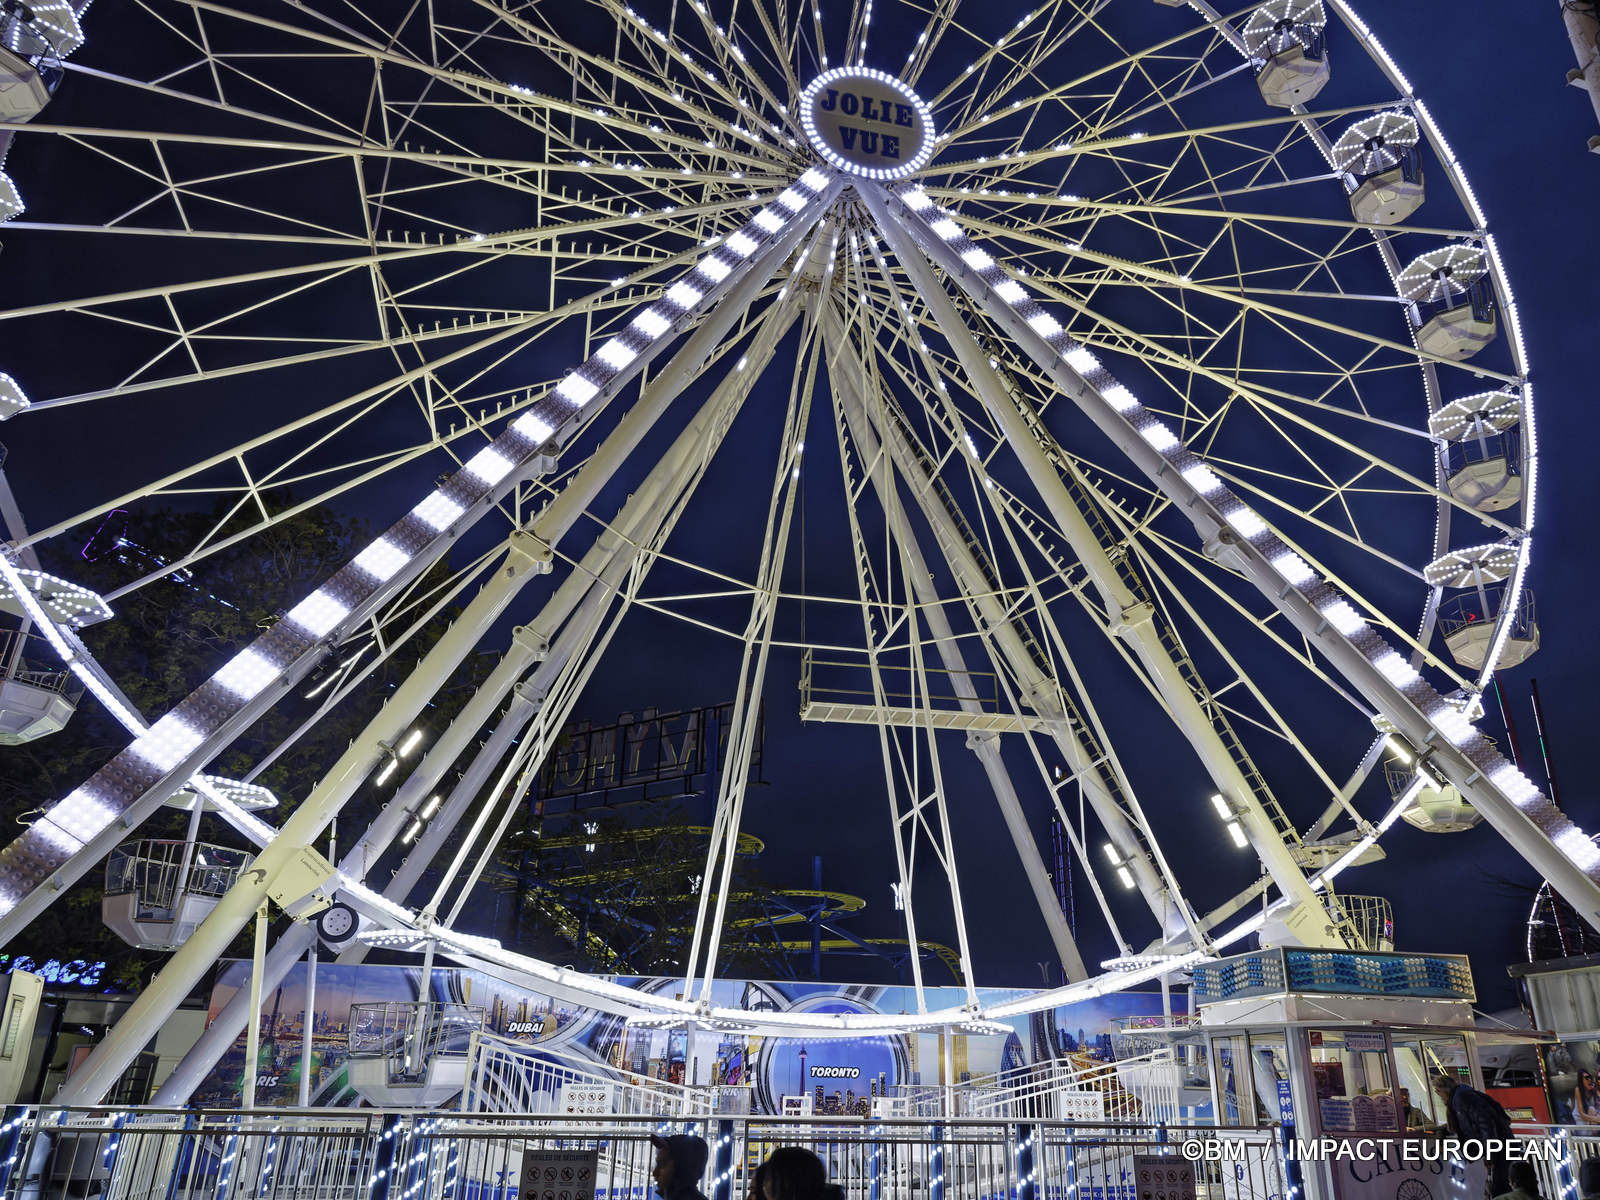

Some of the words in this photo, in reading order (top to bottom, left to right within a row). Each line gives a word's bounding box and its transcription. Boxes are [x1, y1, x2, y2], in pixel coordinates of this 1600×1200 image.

[820, 88, 914, 128] JOLIE
[838, 125, 900, 160] VUE
[507, 1021, 545, 1033] DUBAI
[810, 1066, 860, 1078] TORONTO
[240, 1075, 279, 1087] RIS
